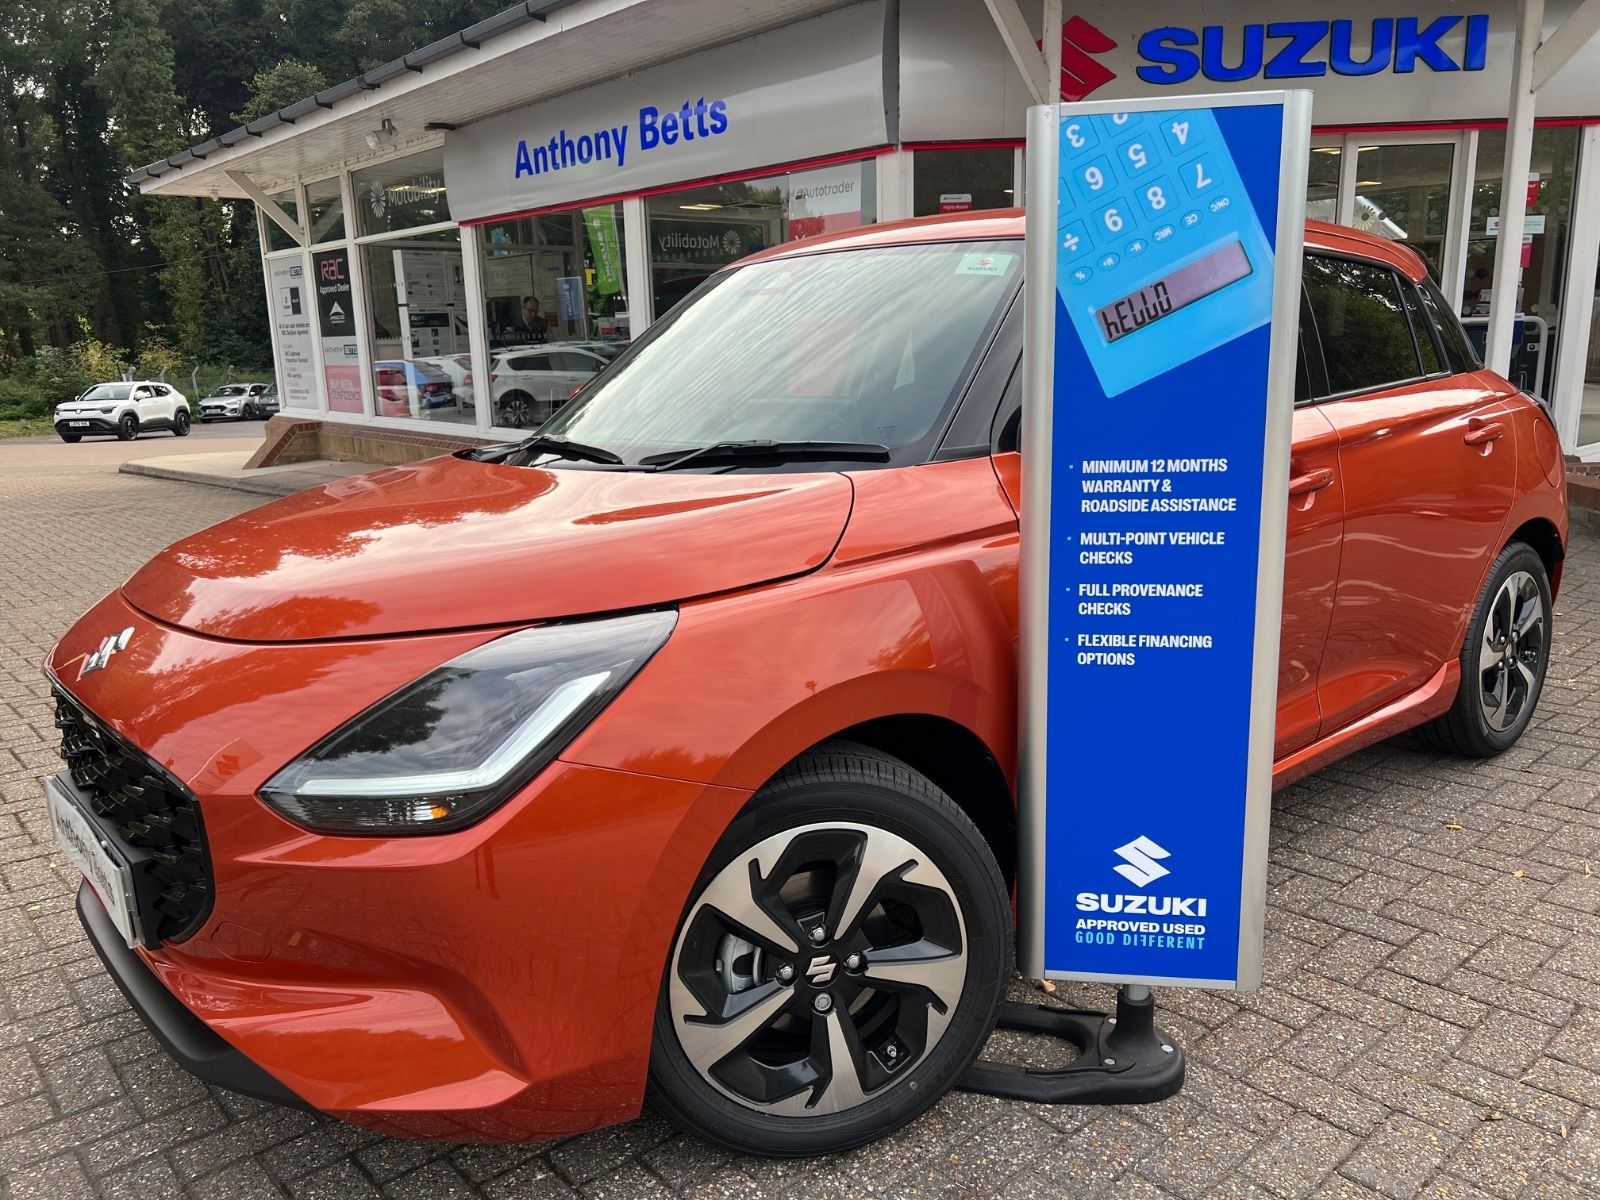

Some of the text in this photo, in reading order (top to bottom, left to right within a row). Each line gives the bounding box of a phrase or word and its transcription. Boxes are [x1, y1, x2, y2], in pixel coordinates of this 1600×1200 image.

[1136, 14, 1490, 85] SUZUKI
[515, 96, 728, 178] Anthony Betts
[1171, 121, 1190, 145] 4
[1128, 143, 1147, 169] 5
[1195, 163, 1213, 189] 7
[804, 181, 855, 199] Autotrader
[1147, 186, 1166, 210] 8
[1082, 458, 1228, 473] MINIMUM 12 MONTHS
[1082, 479, 1172, 493] WARRANTY &
[1081, 498, 1237, 513] ROADSIDE ASSISTANCE
[1080, 532, 1225, 545] MULTI-POINT VEHICLE
[1079, 551, 1133, 564] CHECKS
[1078, 583, 1204, 597] FULL PROVENANCE
[1078, 602, 1131, 615] CHECKS
[1077, 634, 1213, 648] FLEXIBLE FINANCING
[1077, 652, 1136, 666] OPTIONS
[1075, 892, 1208, 917] SUZUKI
[1075, 918, 1206, 935] APPROVED USED
[1075, 931, 1205, 950] GOOD DIFFERENT
